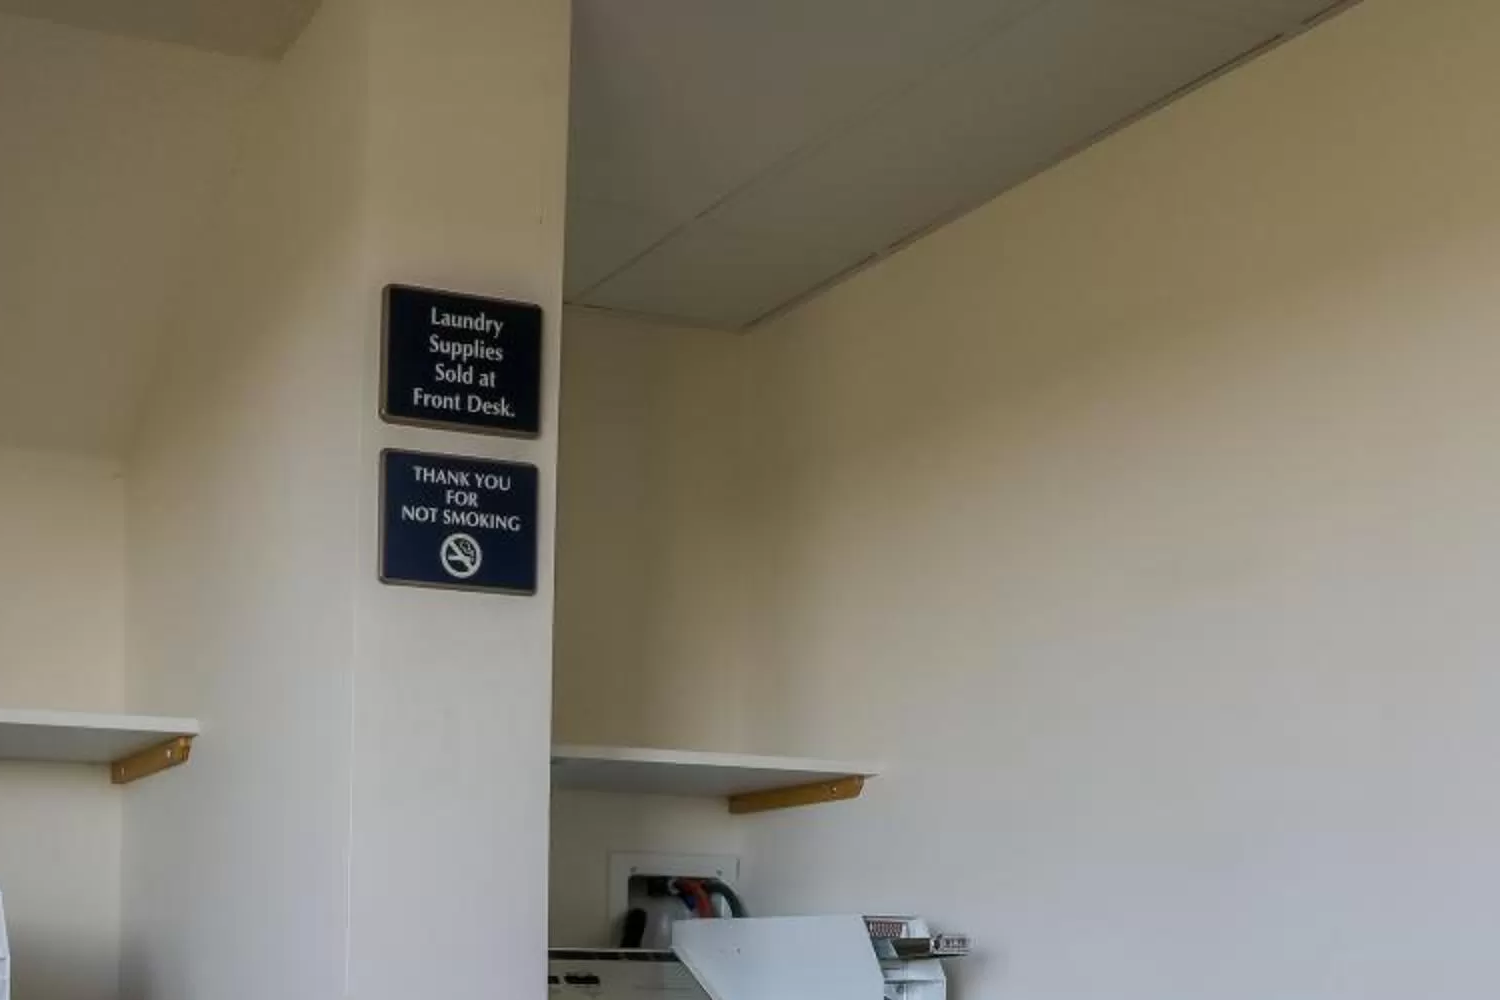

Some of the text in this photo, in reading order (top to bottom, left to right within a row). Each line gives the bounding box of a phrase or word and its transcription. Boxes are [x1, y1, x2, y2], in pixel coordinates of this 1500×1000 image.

[430, 306, 504, 339] Laundry
[429, 333, 504, 363] Supplies
[435, 363, 496, 388] Sold at
[412, 387, 516, 418] Front Desk.
[413, 465, 511, 491] THANK YOU
[445, 489, 478, 507] FOR
[401, 505, 521, 532] NOT SMOKING
